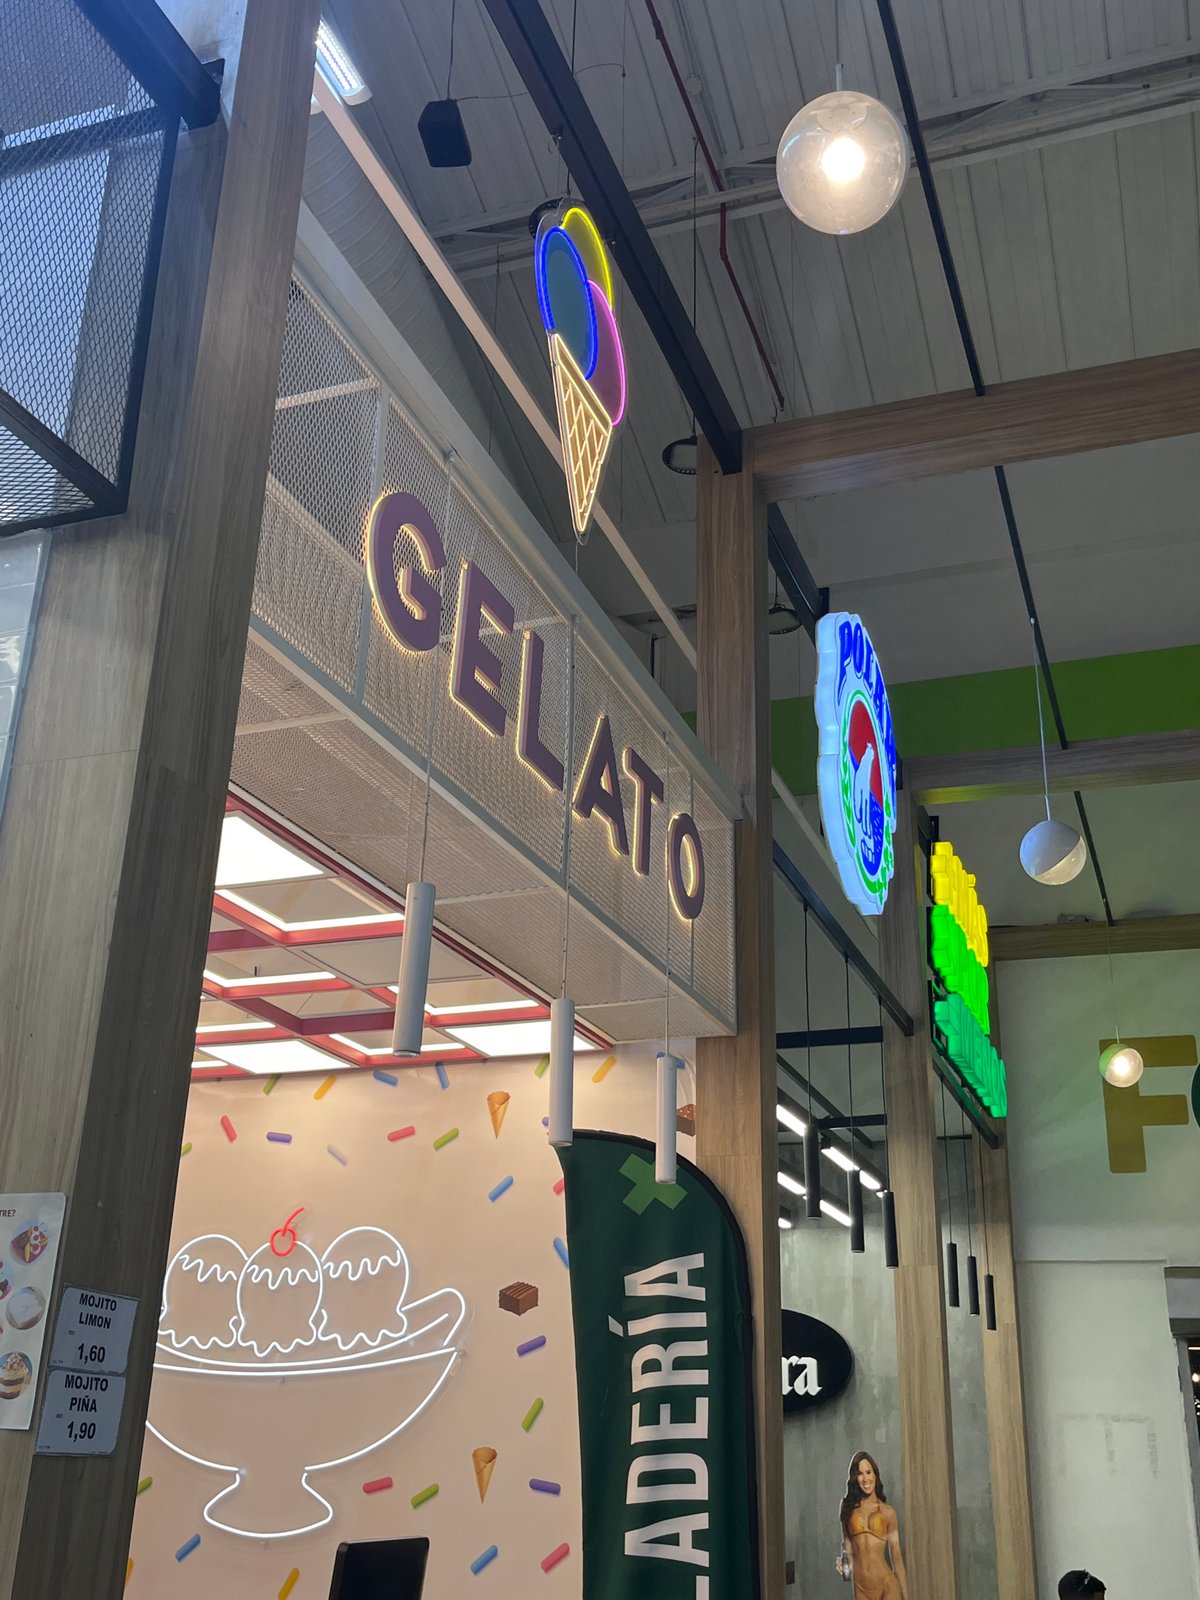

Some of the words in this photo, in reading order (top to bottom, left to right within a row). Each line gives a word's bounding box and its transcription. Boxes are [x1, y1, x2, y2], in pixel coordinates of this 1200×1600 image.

[366, 490, 705, 920] GELATO
[837, 620, 897, 820] POLAR
[79, 1292, 117, 1311] MOJITO
[79, 1311, 112, 1329] LIMON
[78, 1342, 106, 1365] 1,60
[64, 1374, 109, 1392] MOJITO
[69, 1394, 97, 1413] PIÑA
[67, 1421, 96, 1443] 1,90
